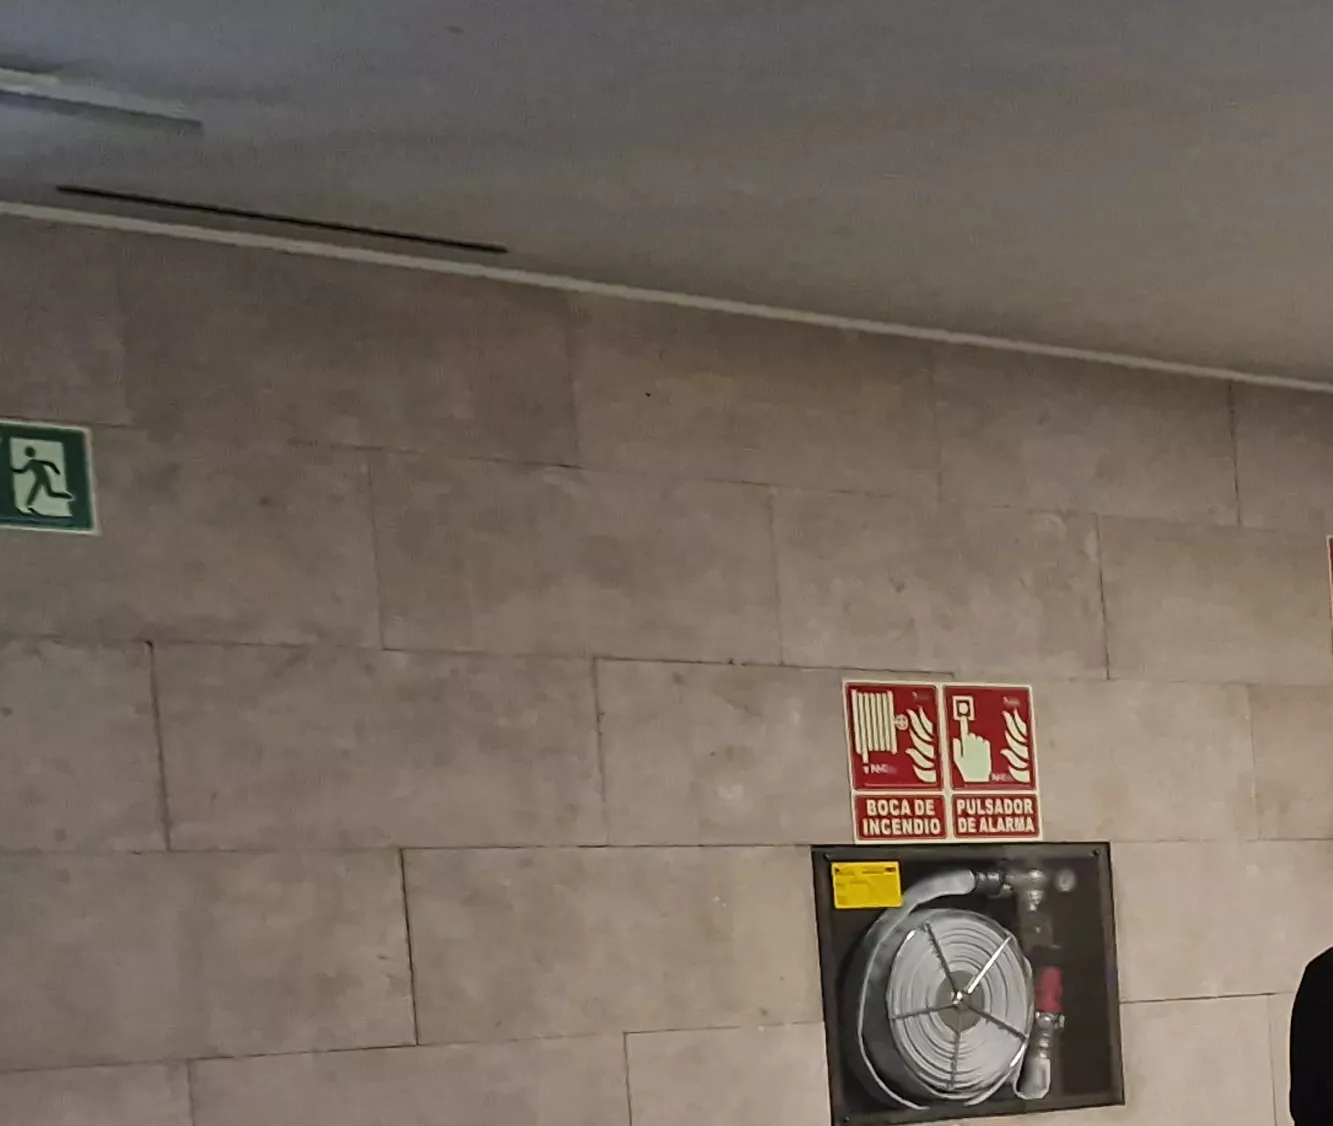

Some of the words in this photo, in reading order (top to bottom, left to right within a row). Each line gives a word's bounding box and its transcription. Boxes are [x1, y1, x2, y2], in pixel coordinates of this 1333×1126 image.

[866, 799, 910, 816] BOCA
[914, 799, 936, 816] DE
[956, 798, 1033, 815] PULSADOR
[863, 818, 941, 835] INCENDIO
[957, 817, 977, 833] DE
[979, 816, 1035, 833] ALARMA
